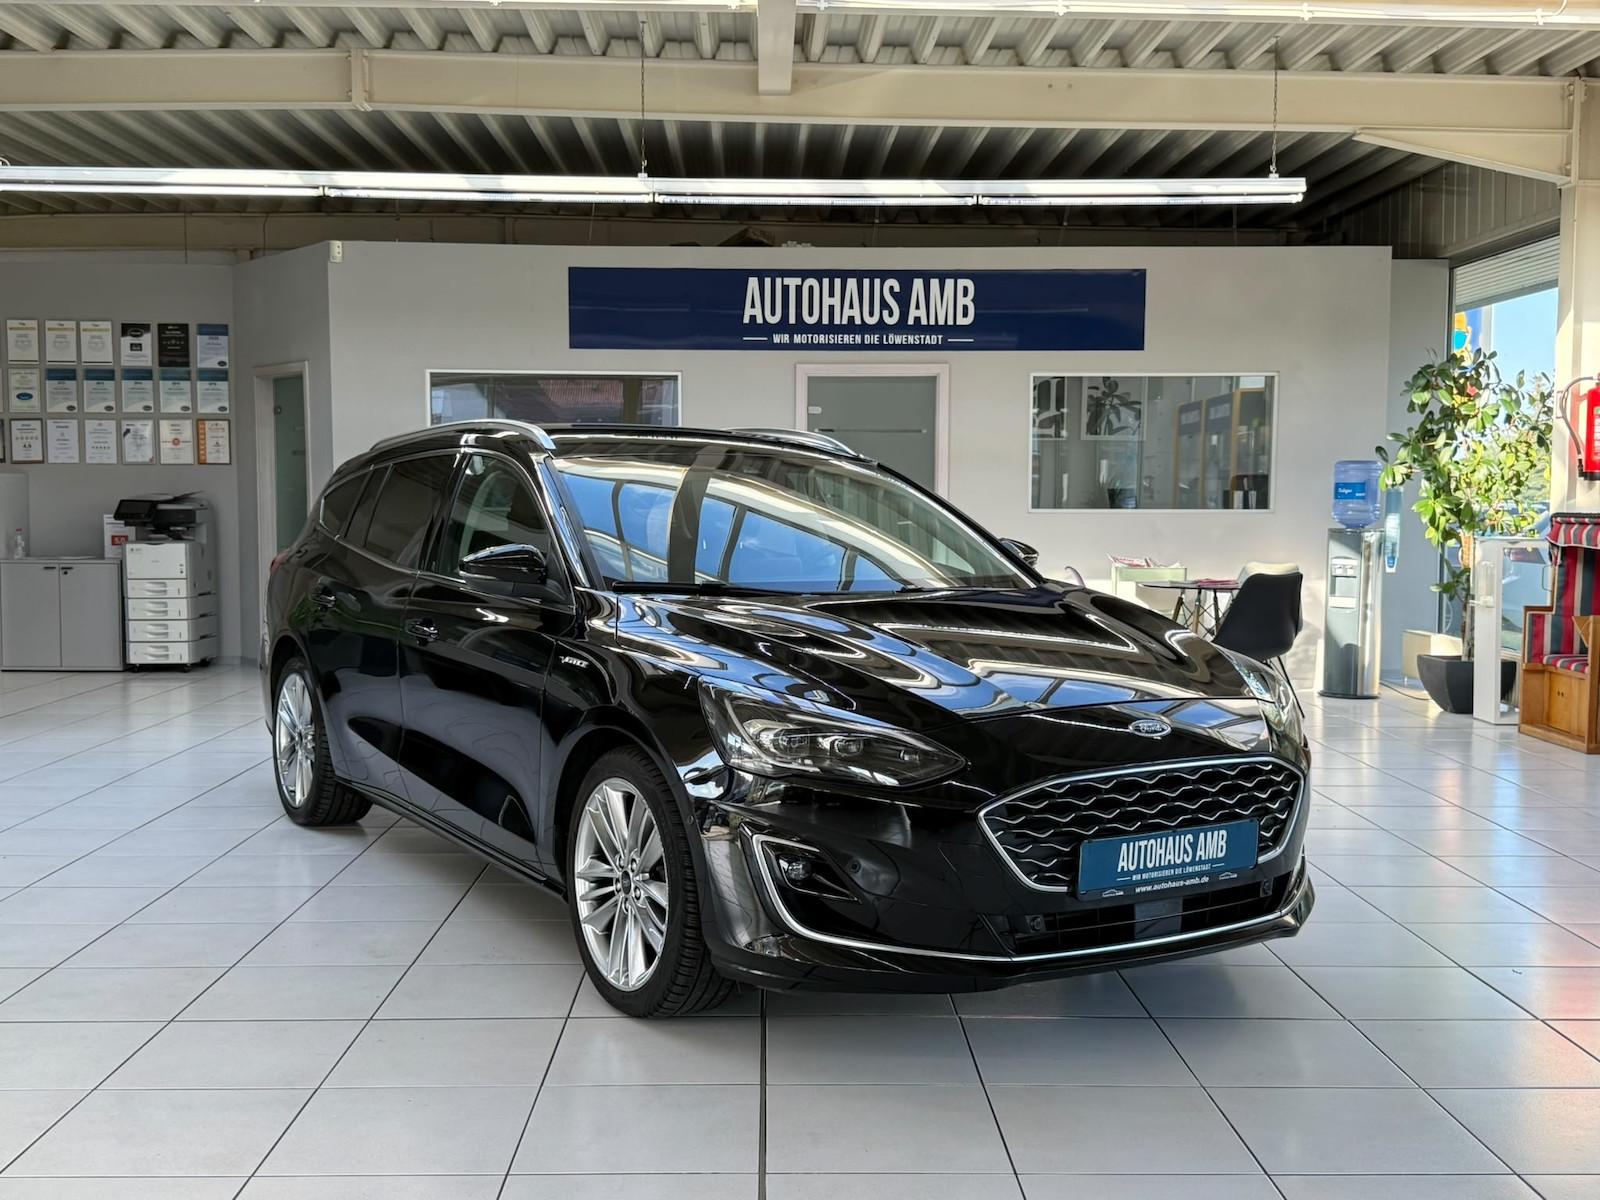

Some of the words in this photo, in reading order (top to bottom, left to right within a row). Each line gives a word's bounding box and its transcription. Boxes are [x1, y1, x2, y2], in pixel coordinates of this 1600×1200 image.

[743, 276, 900, 325] AUTOHAUS
[907, 278, 976, 326] AMB
[773, 333, 790, 344] WIR
[793, 334, 861, 345] MOTORISIEREN
[864, 335, 880, 345] DIE
[882, 333, 943, 345] LÖWENSTADT
[1117, 834, 1193, 872] AUTOHAUS
[1195, 830, 1227, 861] AMB
[1135, 876, 1209, 892] www.autohaus-amb.de
